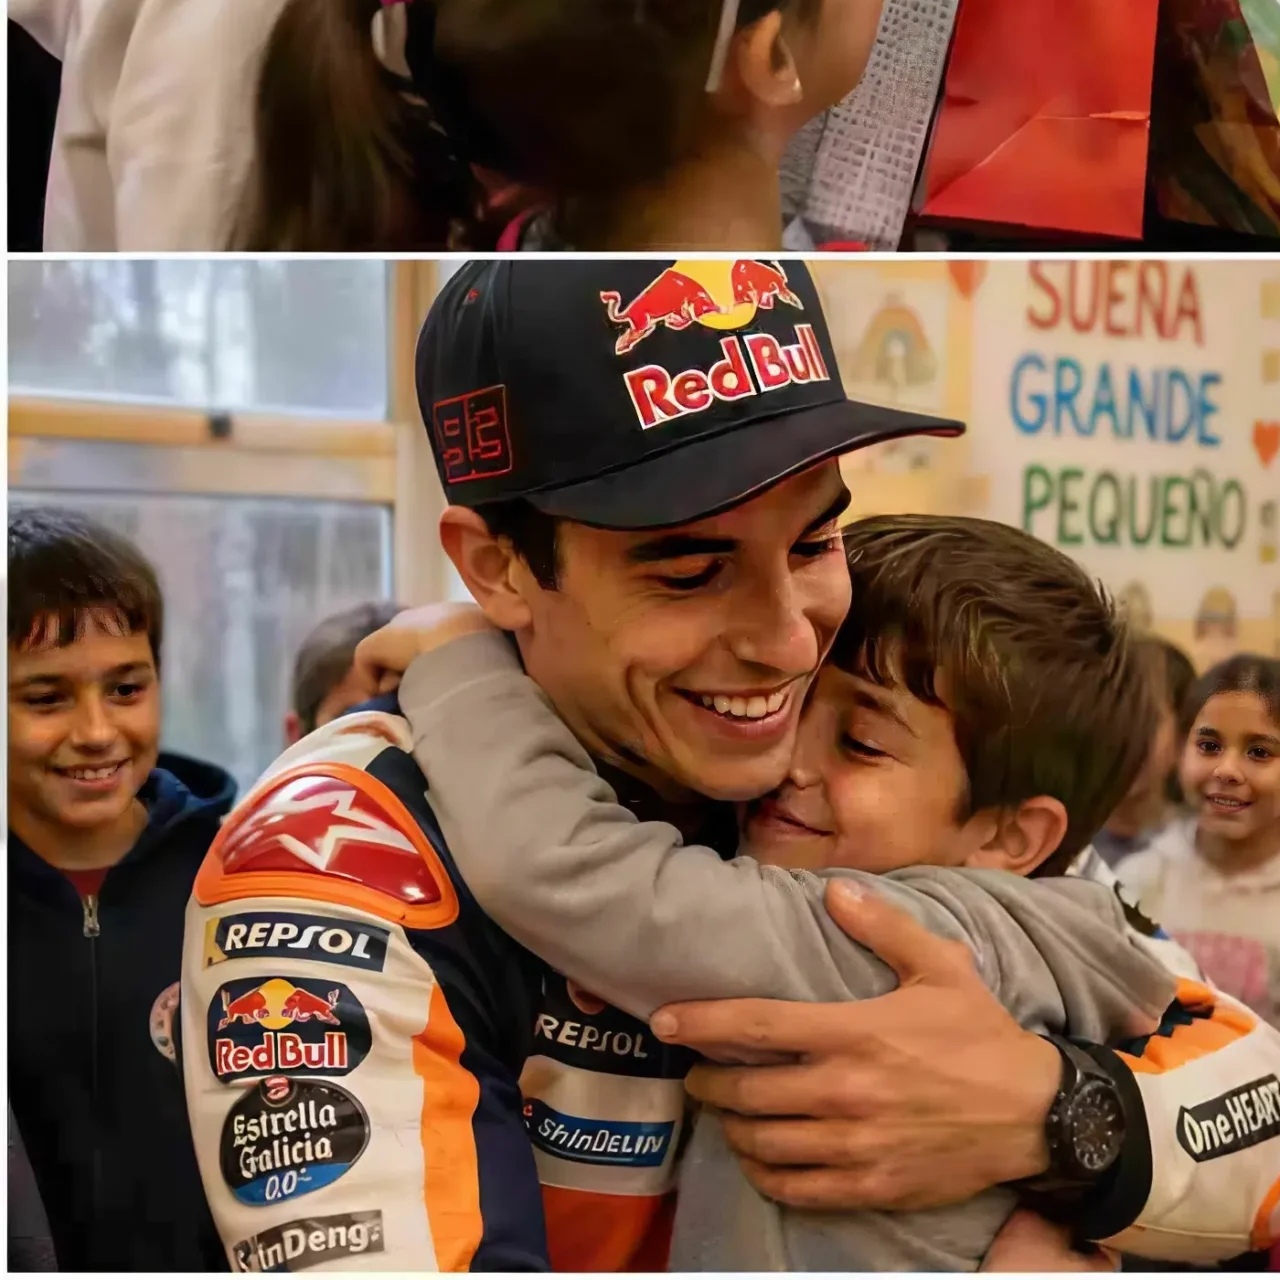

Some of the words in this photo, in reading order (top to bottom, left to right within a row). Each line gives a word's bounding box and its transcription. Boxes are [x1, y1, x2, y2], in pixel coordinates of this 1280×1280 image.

[623, 335, 758, 430] Red
[747, 323, 831, 393] Bull
[1009, 352, 1225, 448] GRANDE
[1023, 462, 1249, 552] PEQUEÑO
[224, 922, 372, 959] REPSOL
[215, 1032, 274, 1075] Red
[277, 1032, 349, 1069] Bull
[534, 1014, 648, 1058] REPSOL
[233, 1100, 337, 1145] Estrella
[239, 1132, 333, 1179] Galicia
